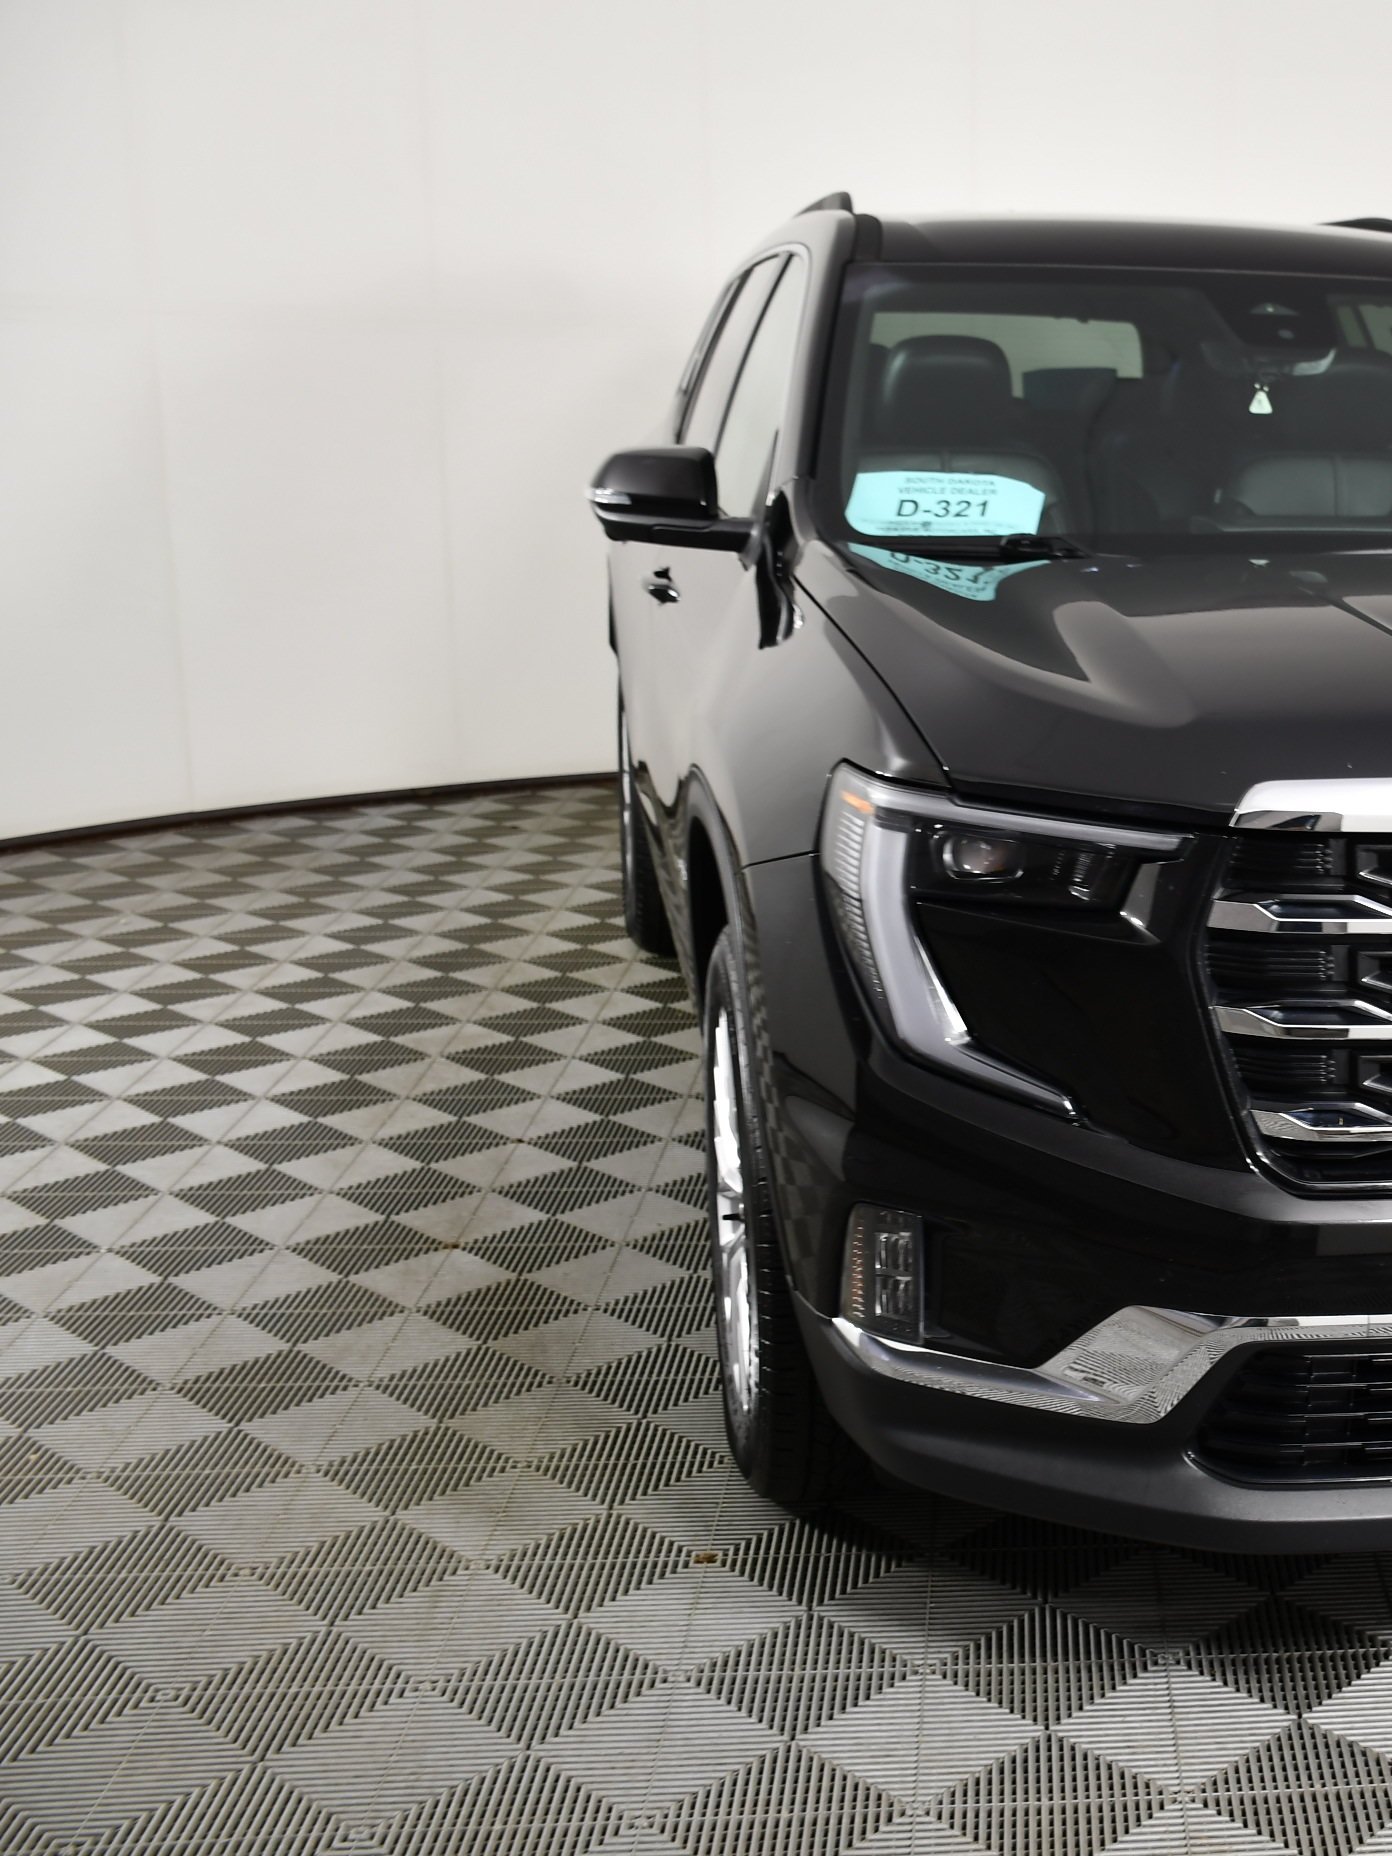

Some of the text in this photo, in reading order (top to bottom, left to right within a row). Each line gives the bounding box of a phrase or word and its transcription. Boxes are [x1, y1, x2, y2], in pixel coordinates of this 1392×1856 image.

[905, 477, 995, 487] SOUTH DAKOTA
[898, 487, 997, 496] VEHICLE DEALER
[896, 499, 990, 518] D-321
